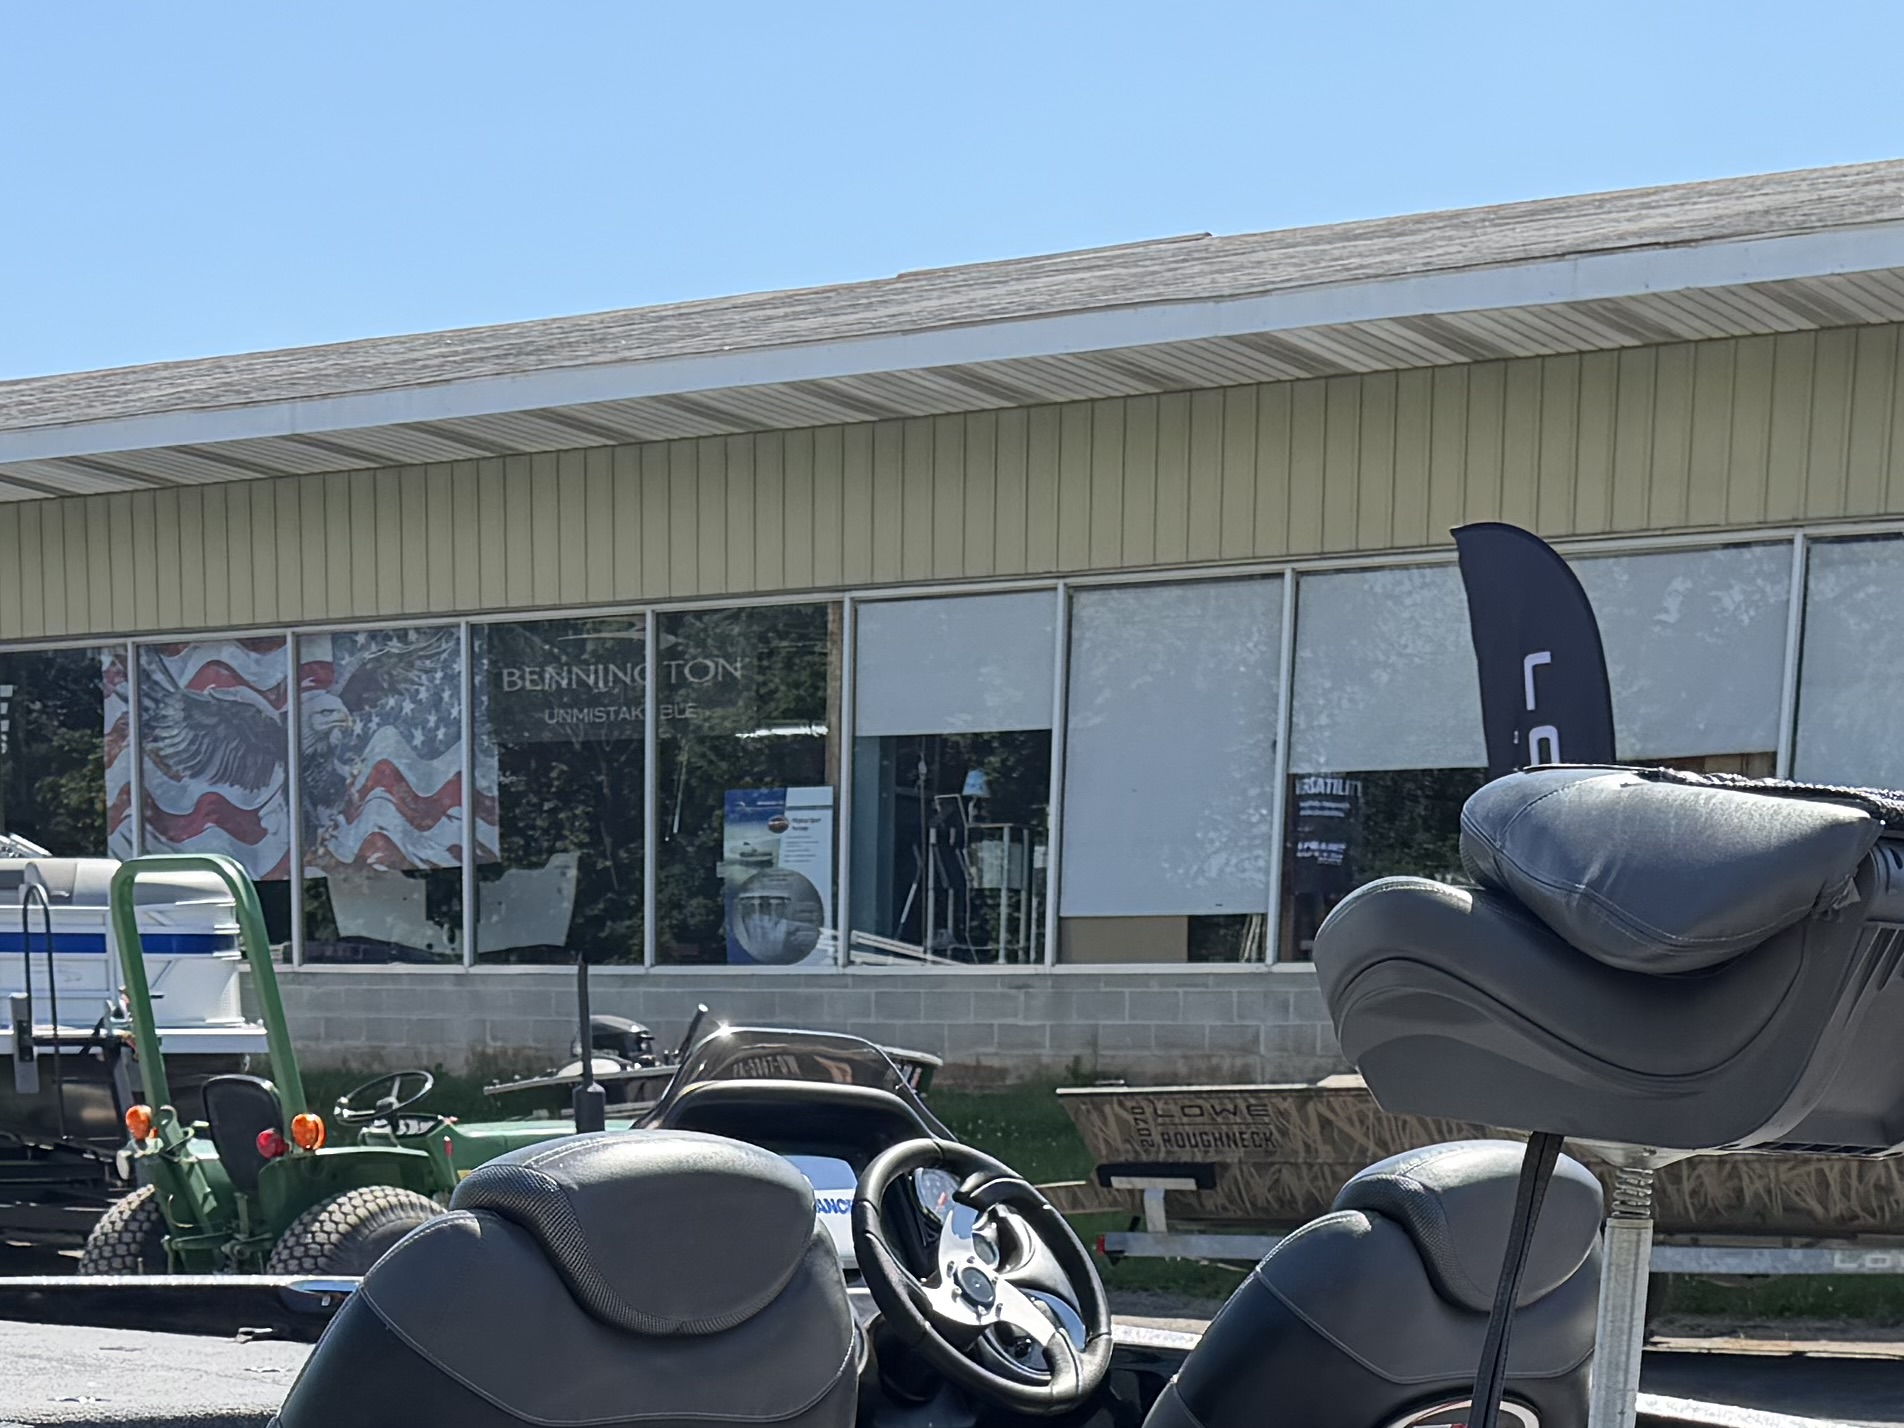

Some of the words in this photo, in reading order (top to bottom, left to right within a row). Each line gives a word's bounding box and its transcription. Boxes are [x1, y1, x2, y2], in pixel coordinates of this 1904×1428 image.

[545, 702, 698, 724] UNMISTAKBLE
[1153, 1102, 1270, 1119] LOWE
[1130, 1105, 1156, 1149] 2070
[1162, 1131, 1276, 1150] ROUGHNECK
